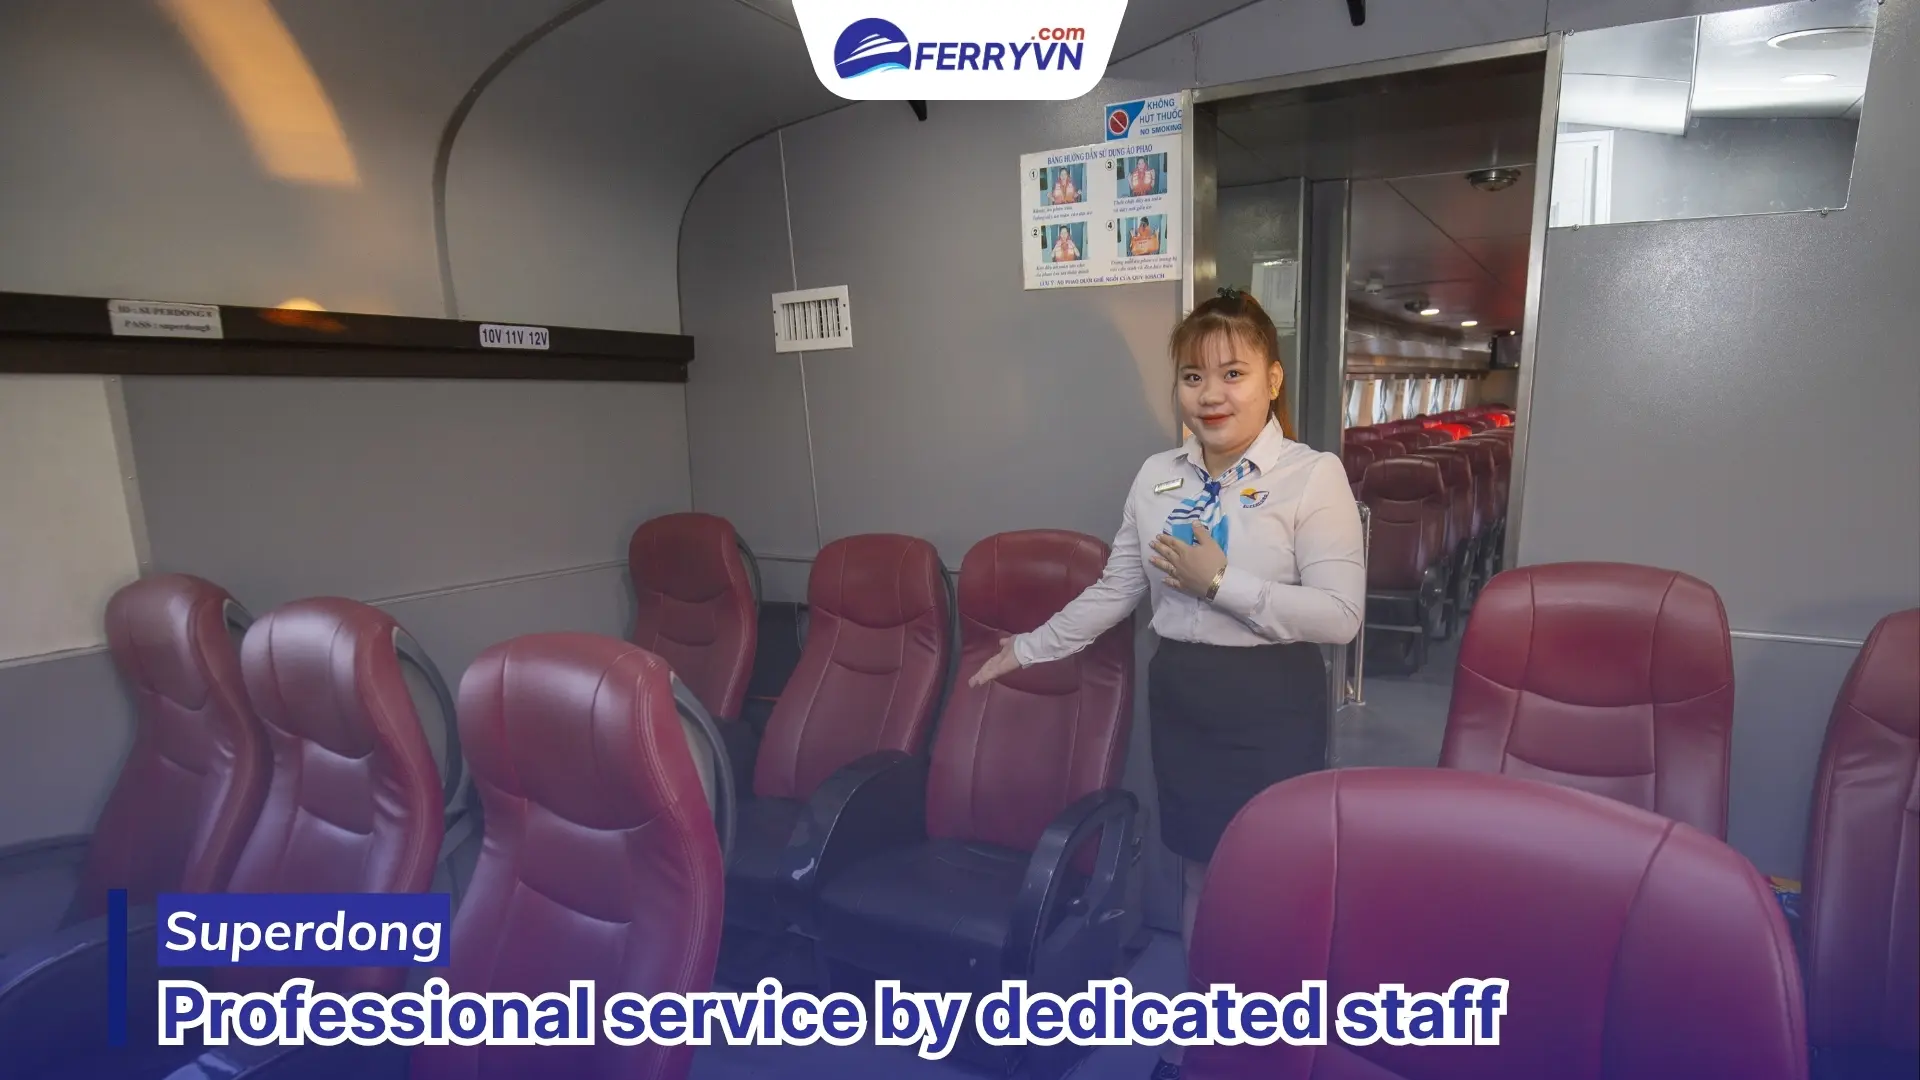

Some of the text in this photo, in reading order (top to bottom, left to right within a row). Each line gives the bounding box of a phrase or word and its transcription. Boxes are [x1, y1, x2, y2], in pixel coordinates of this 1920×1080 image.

[1148, 98, 1175, 111] KHÔNG
[1140, 107, 1182, 124] HÚT THUỐC
[1140, 123, 1182, 136] NO SMOKING
[1136, 144, 1153, 154] PHAO
[482, 328, 547, 346] 10V 11V 12V
